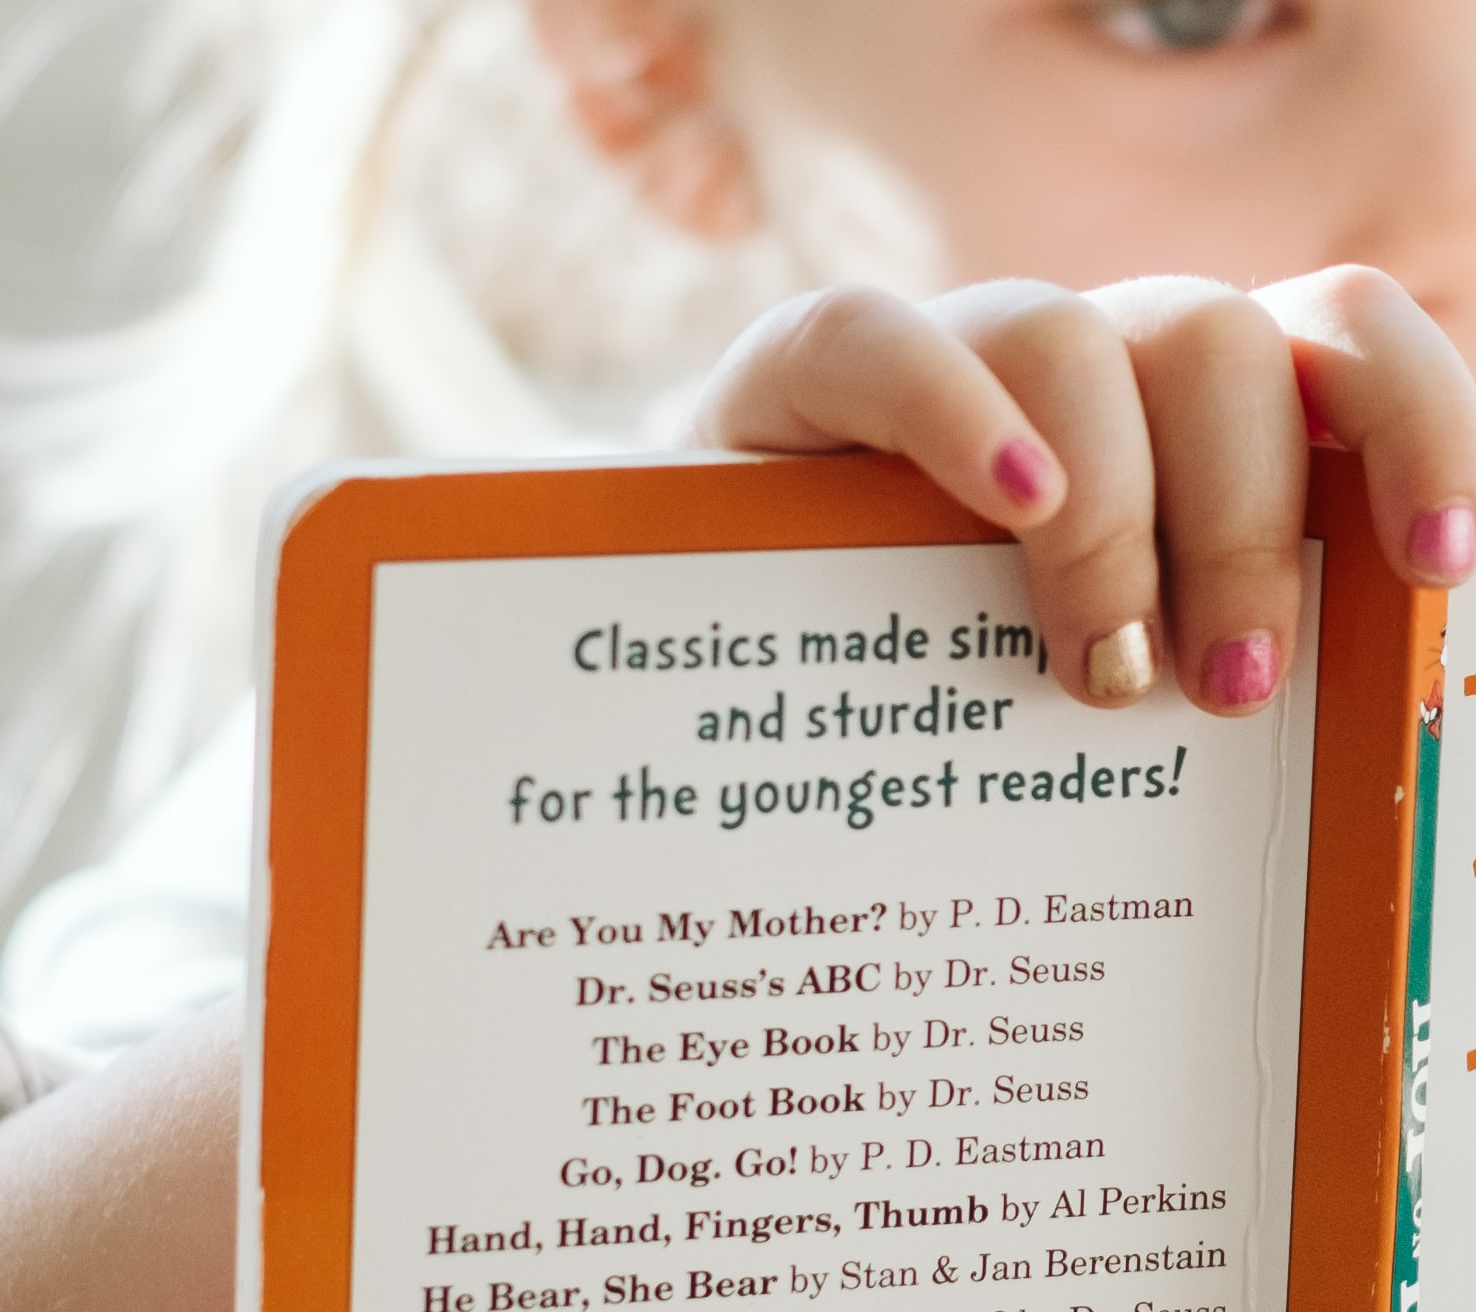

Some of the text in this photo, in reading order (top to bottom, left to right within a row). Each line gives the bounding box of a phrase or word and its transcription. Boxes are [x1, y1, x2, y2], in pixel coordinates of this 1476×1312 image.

[573, 612, 1048, 674] Classics made sim
[697, 685, 1014, 742] and sturdier
[509, 745, 1187, 831] for the youngest readers!
[487, 894, 1193, 950] Are You My Mother? by P. D. Eastman
[577, 956, 1105, 1006] Dr. Seuss's ABC by Dr. Seuss
[593, 1016, 1084, 1067] The Eye Book by Dr. Seuss
[583, 1075, 1089, 1126] The Foot Book by Dr. Seuss
[560, 1136, 1104, 1189] Go, Dog. Go! by P. D. Eastman
[428, 1183, 1226, 1255] Hand, Hand, Fingers, Thumb by Al Perkins
[488, 1282, 590, 1312] Bear,
[604, 1274, 673, 1304] She
[687, 1271, 778, 1300] Bear
[791, 1265, 828, 1299] by
[841, 1261, 918, 1290] Stan
[932, 1256, 958, 1285] &
[970, 1253, 1031, 1282] Jan
[1045, 1241, 1226, 1278] Berenstain
